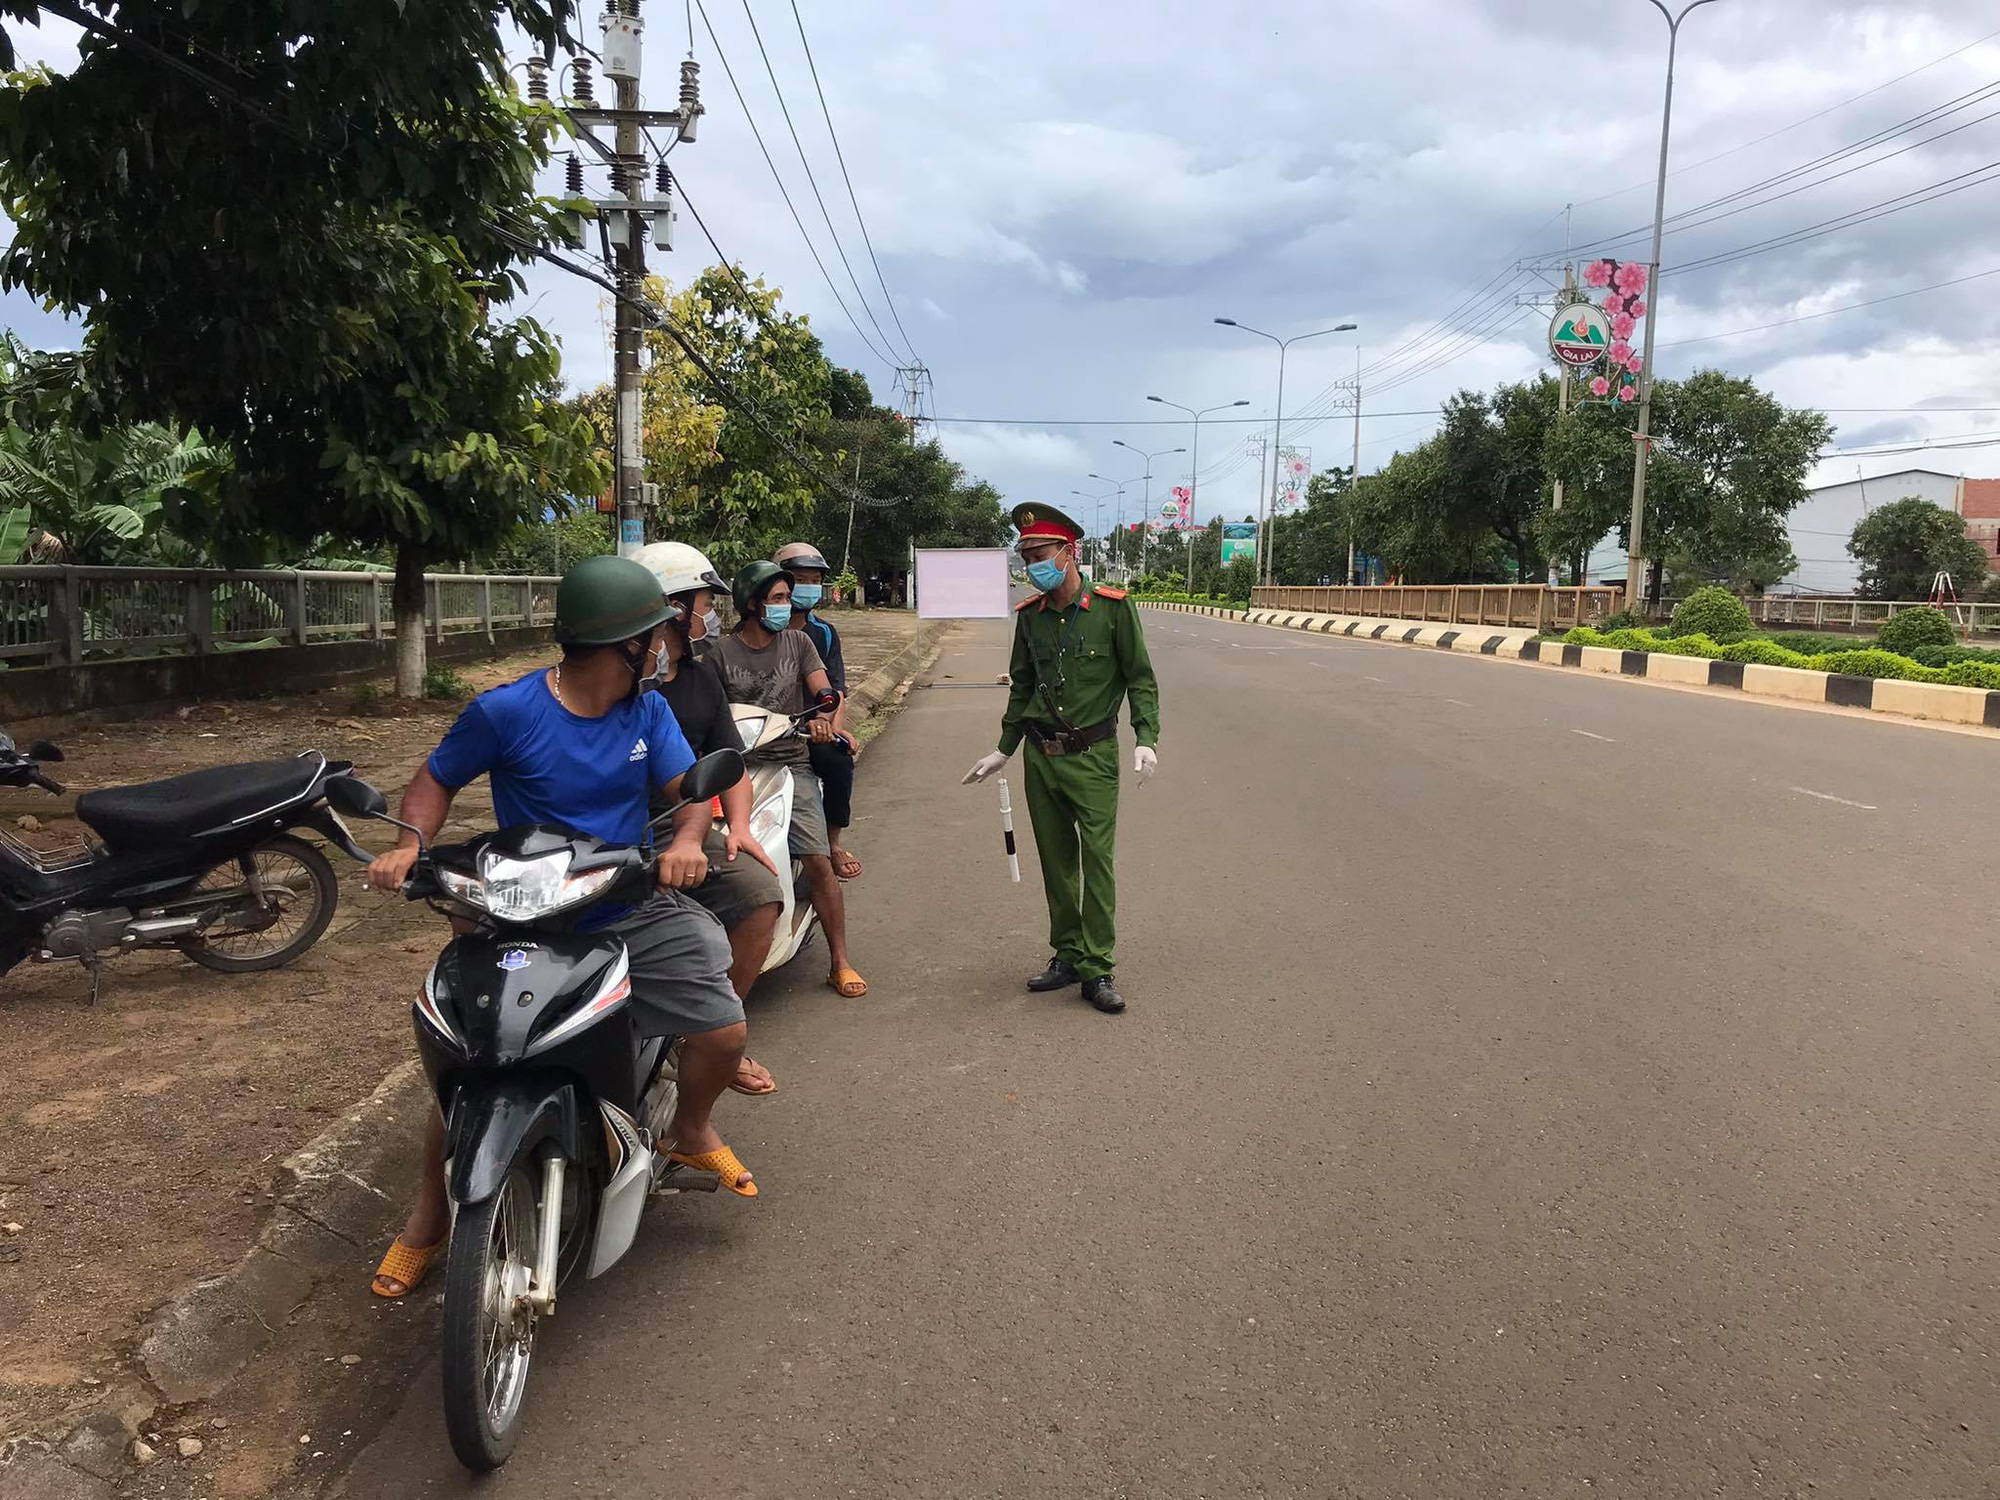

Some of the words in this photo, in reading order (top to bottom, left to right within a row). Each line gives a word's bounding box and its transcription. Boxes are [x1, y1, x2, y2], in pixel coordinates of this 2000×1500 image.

[1563, 349, 1579, 361] GIA
[1580, 351, 1594, 360] LAI
[497, 941, 539, 950] HONDA
